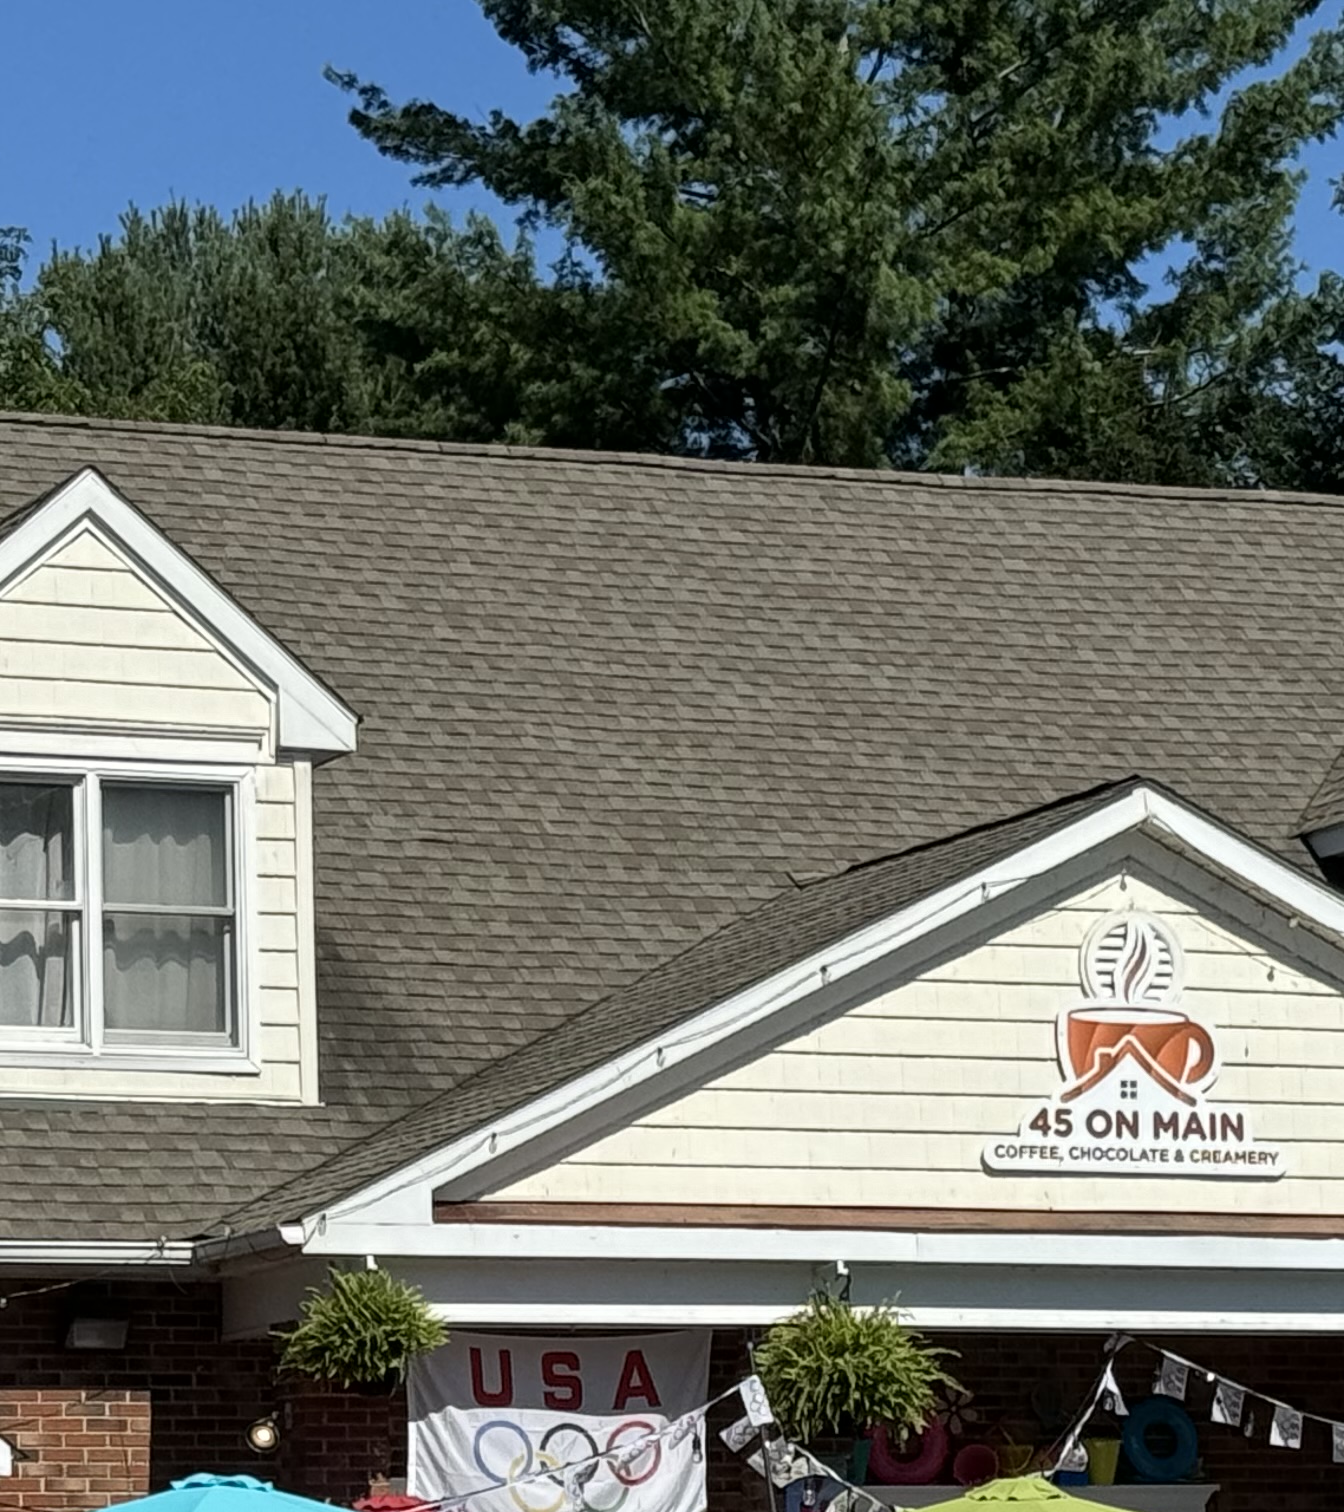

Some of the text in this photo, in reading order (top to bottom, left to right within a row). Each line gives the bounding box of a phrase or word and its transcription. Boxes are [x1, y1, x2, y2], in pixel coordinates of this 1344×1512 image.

[1028, 1107, 1245, 1142] 45 ON MAIN
[993, 1144, 1281, 1167] COFFEE, CHOCOLATE & CREAMERY
[468, 1346, 663, 1412] USA
